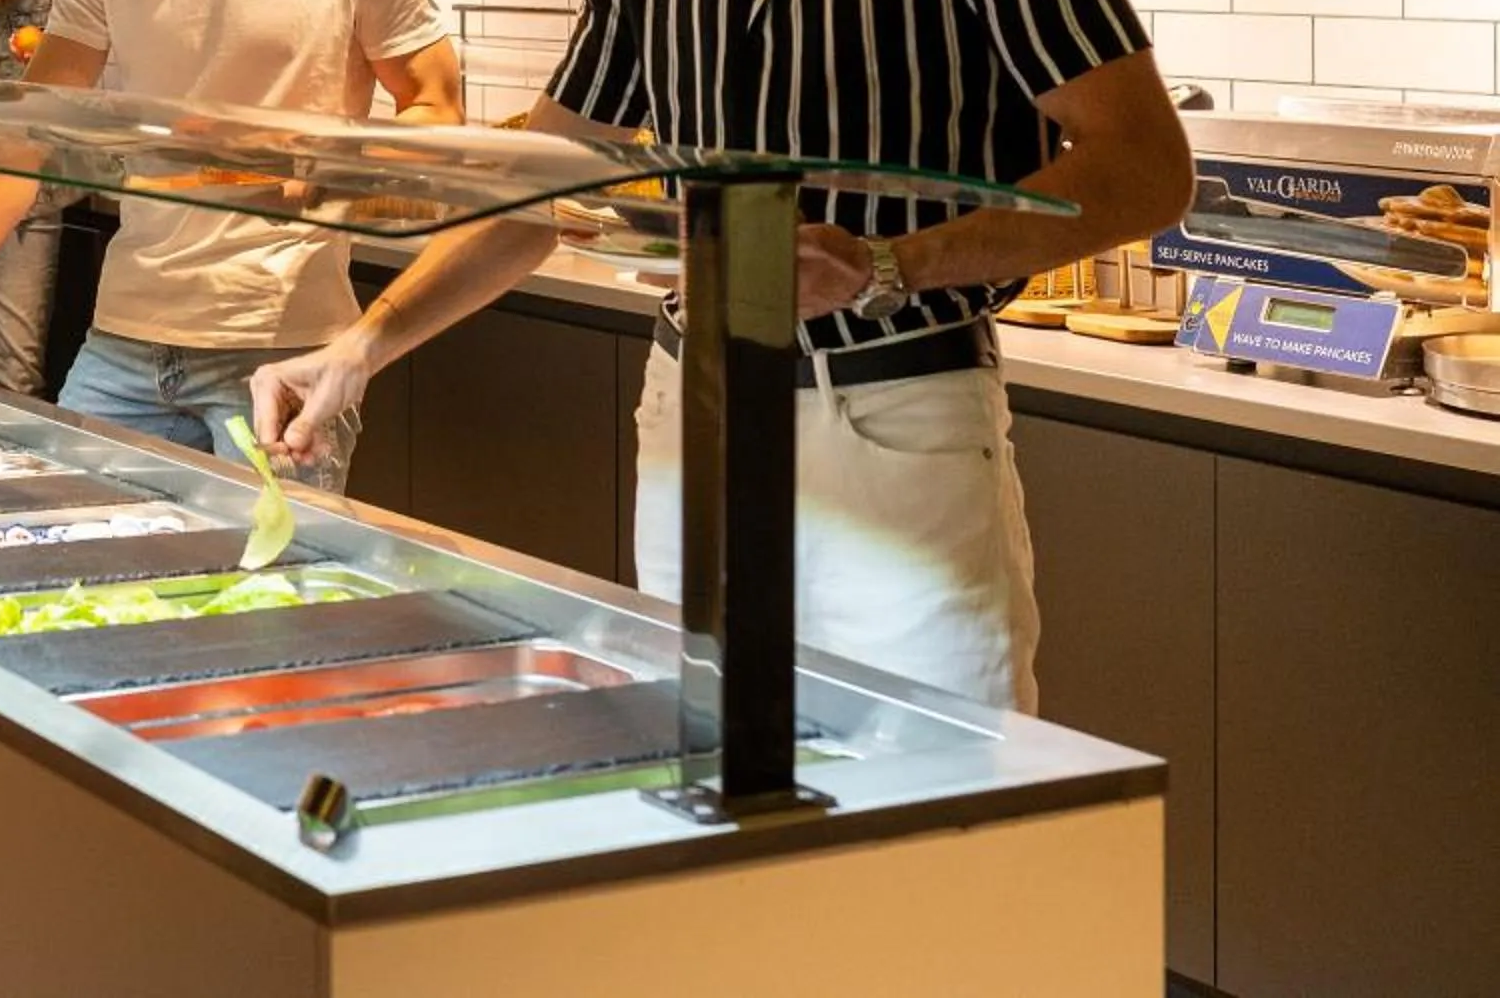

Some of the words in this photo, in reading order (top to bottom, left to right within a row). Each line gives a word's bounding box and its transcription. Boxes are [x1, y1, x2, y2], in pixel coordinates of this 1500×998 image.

[1157, 246, 1213, 265] SELF-SERVE
[1215, 253, 1269, 272] PANCAKES
[1233, 332, 1263, 347] WAVE
[1265, 337, 1280, 349] TO
[1282, 341, 1314, 355] MAKE
[1314, 345, 1373, 365] PANCAKES
